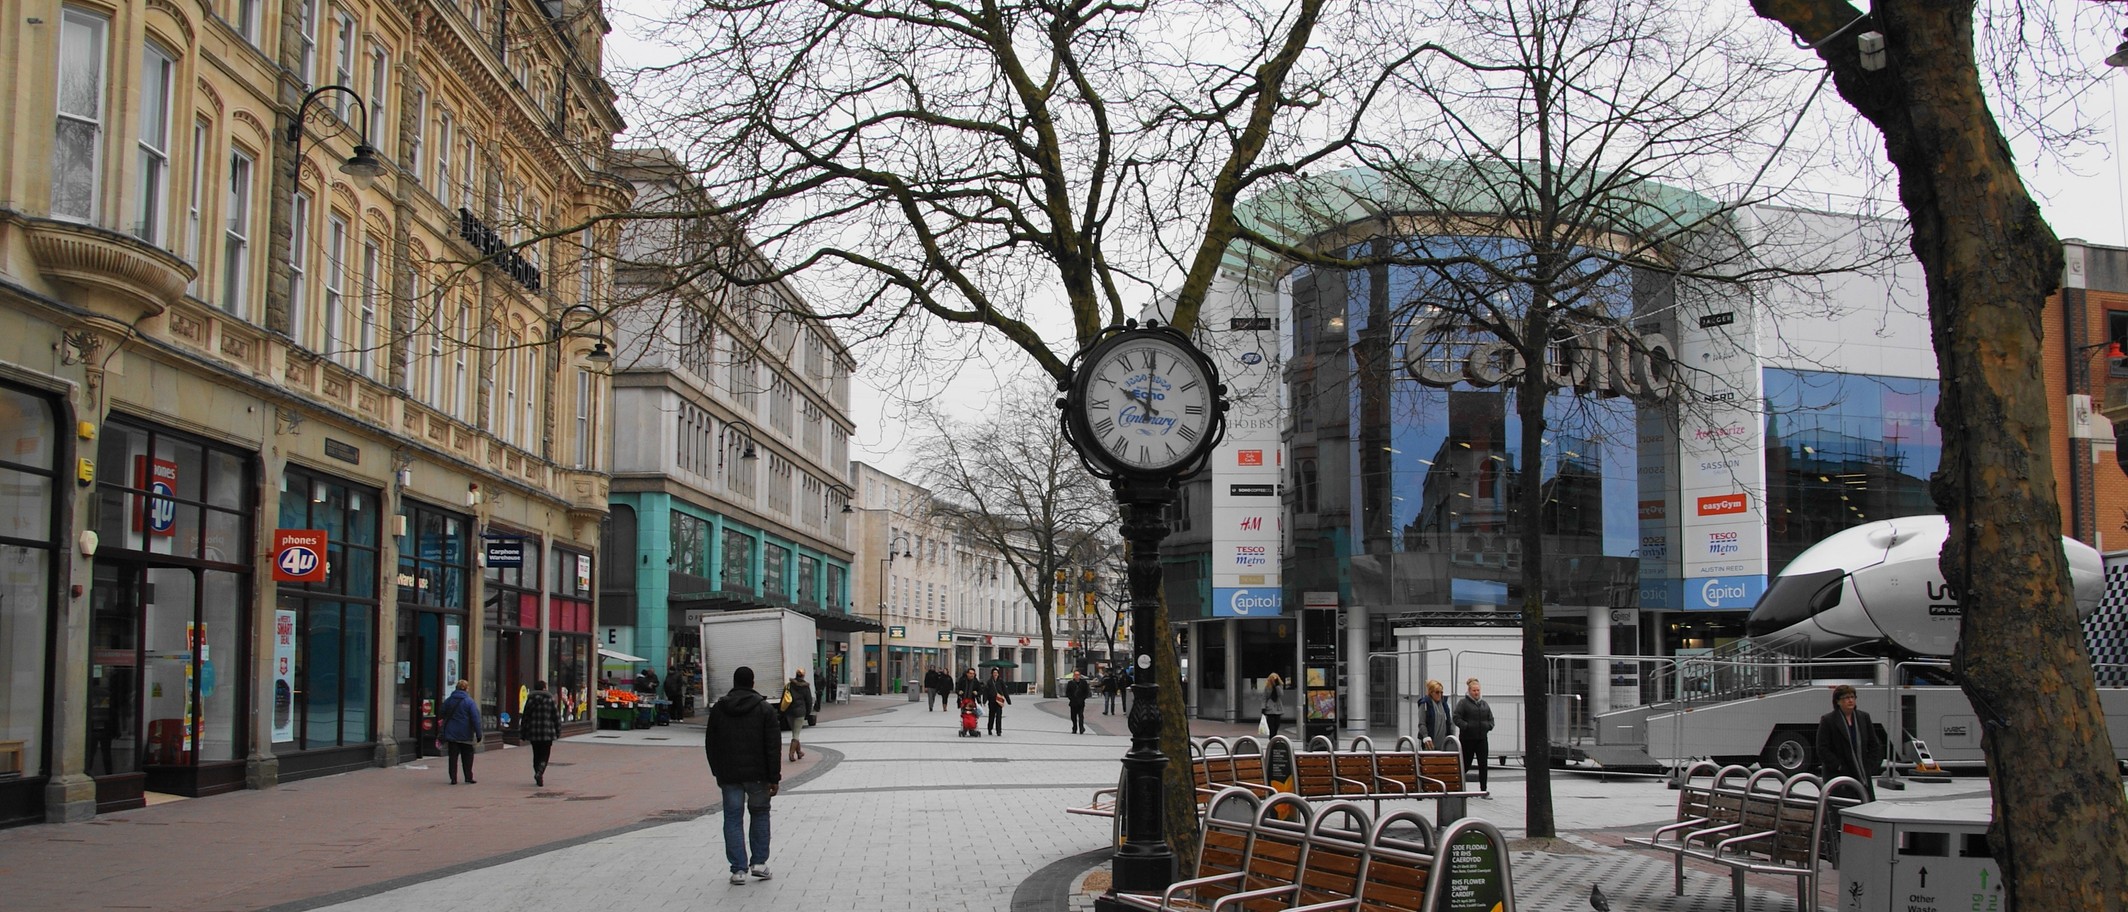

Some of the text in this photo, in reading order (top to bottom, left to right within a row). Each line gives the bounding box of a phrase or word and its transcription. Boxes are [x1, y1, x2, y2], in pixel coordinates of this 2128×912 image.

[1704, 393, 1734, 403] NERO
[1701, 460, 1740, 471] SASSOON
[1702, 500, 1742, 511] easyGym
[1240, 516, 1262, 531] H&M
[282, 535, 317, 546] phones
[1710, 532, 1738, 540] TESCO
[489, 548, 520, 556] Carphone
[282, 548, 315, 574] 4u
[1702, 579, 1745, 607] Capitol
[1231, 589, 1276, 615] Capitol
[1909, 894, 1936, 904] Other
[1907, 904, 1937, 912] Waste
